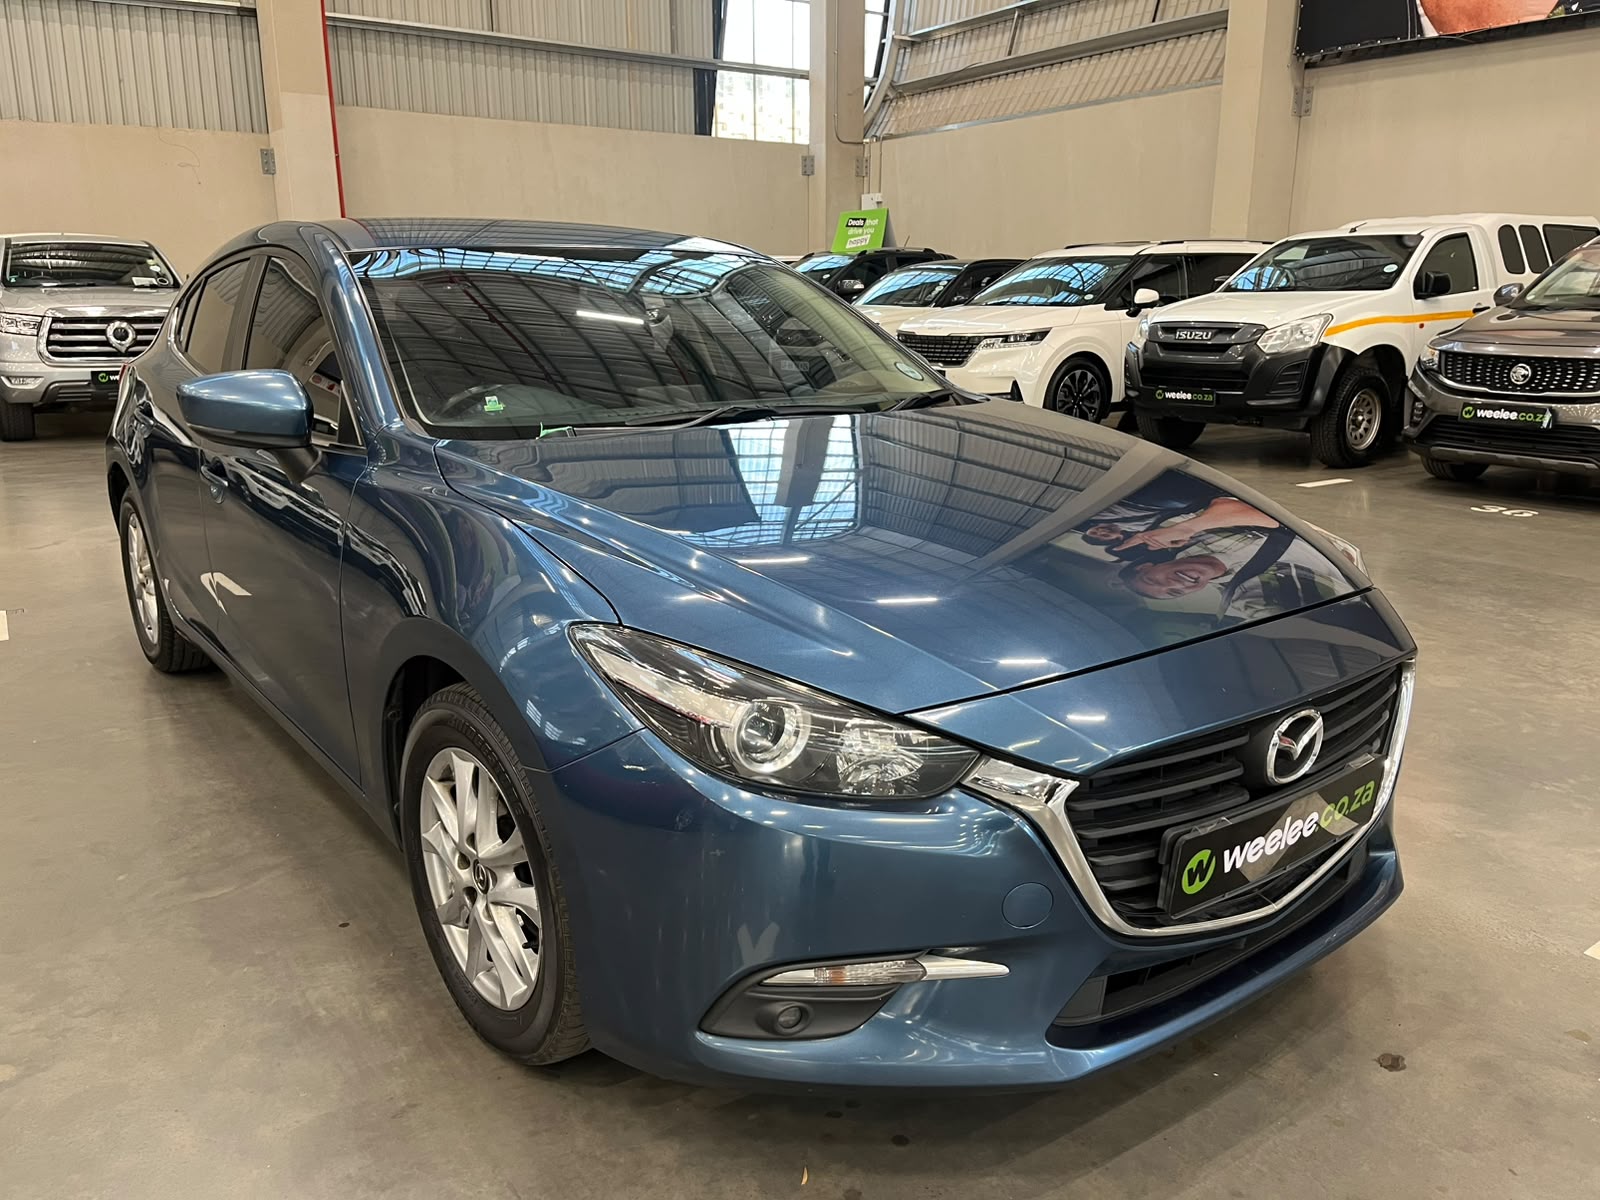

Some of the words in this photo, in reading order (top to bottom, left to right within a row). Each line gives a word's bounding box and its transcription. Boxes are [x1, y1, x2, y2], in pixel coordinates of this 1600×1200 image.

[863, 227, 875, 235] you
[848, 237, 869, 246] happy
[1175, 331, 1212, 340] ISUZU
[1223, 780, 1376, 873] weelee.co.za
